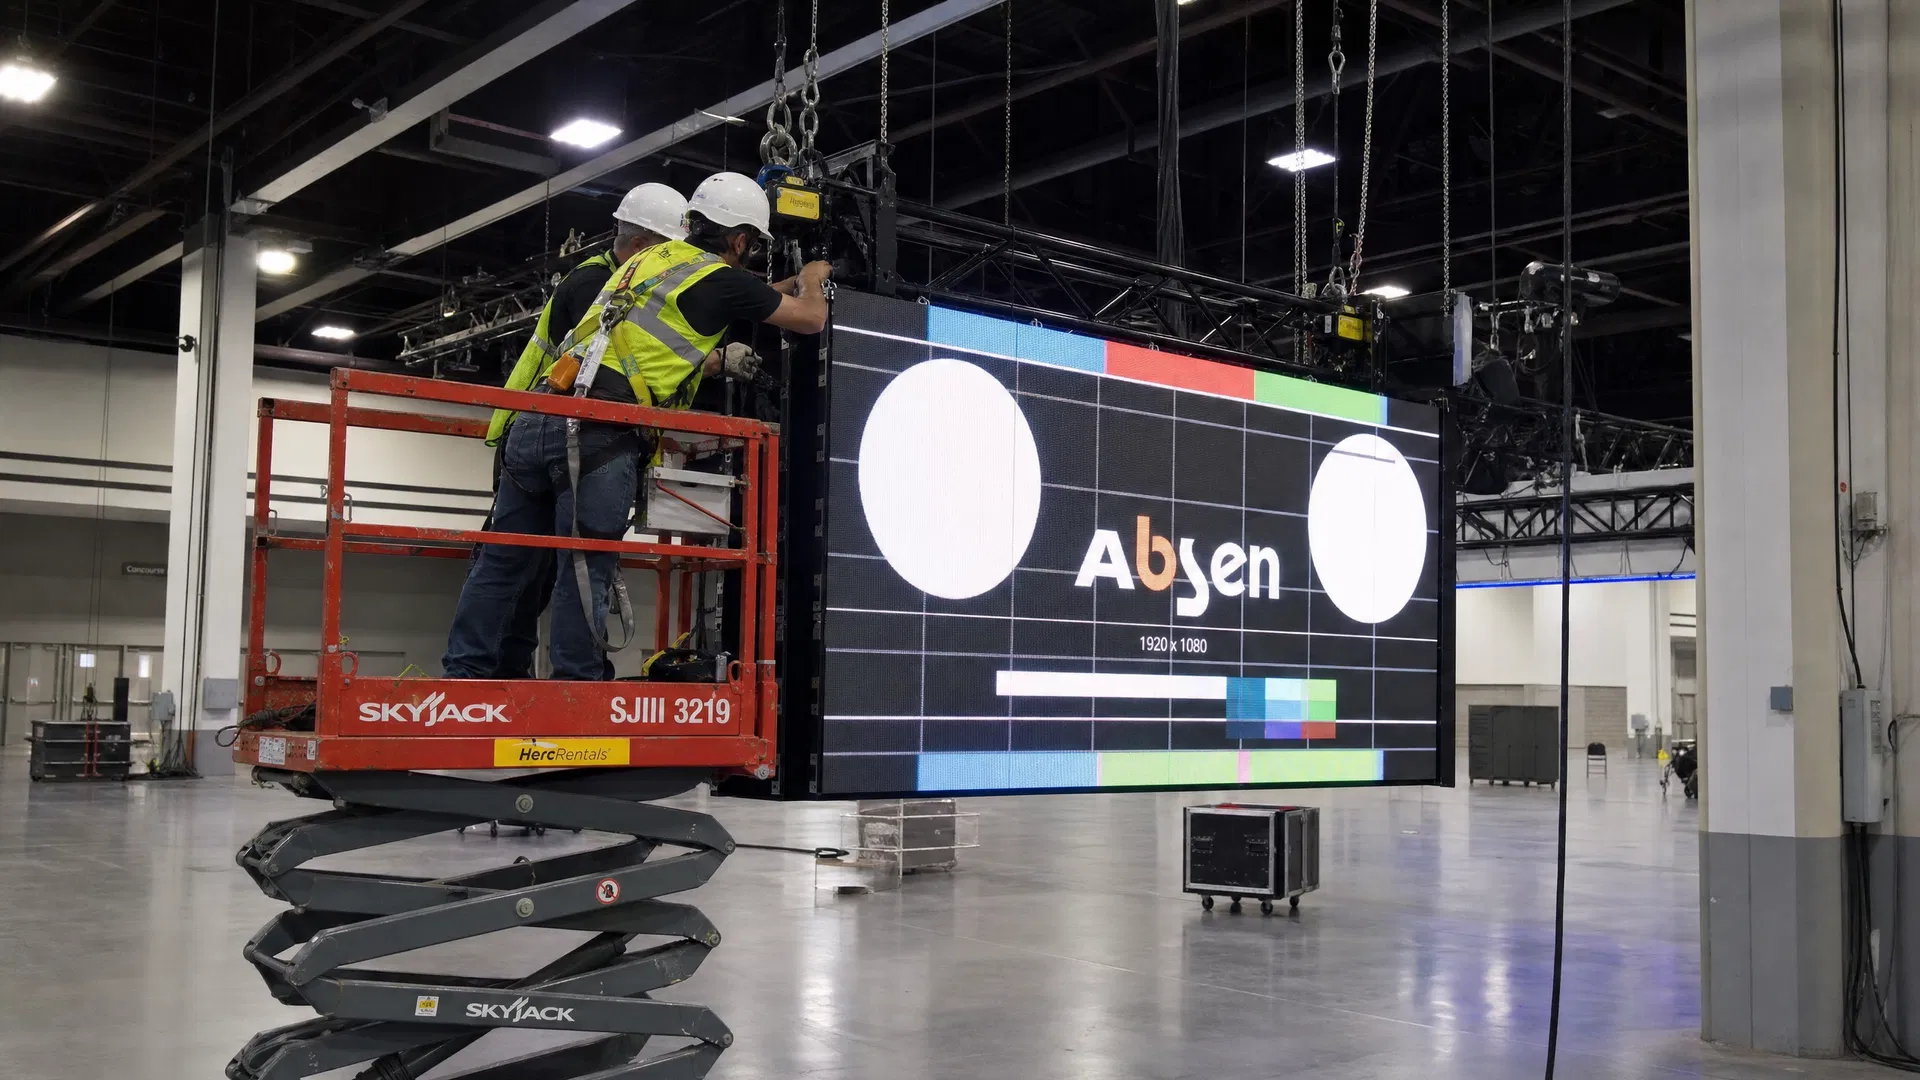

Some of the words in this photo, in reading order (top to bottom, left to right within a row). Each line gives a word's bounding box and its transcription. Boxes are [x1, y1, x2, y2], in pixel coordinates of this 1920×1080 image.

[126, 565, 165, 574] Concourse
[1074, 515, 1280, 617] Absen
[1140, 636, 1168, 651] 1920
[1169, 640, 1177, 652] x
[1180, 637, 1208, 653] 1080
[359, 691, 510, 727] SKYJACK
[610, 696, 665, 724] SJIII
[673, 697, 730, 724] 3219
[465, 996, 575, 1023] SKYJACK
